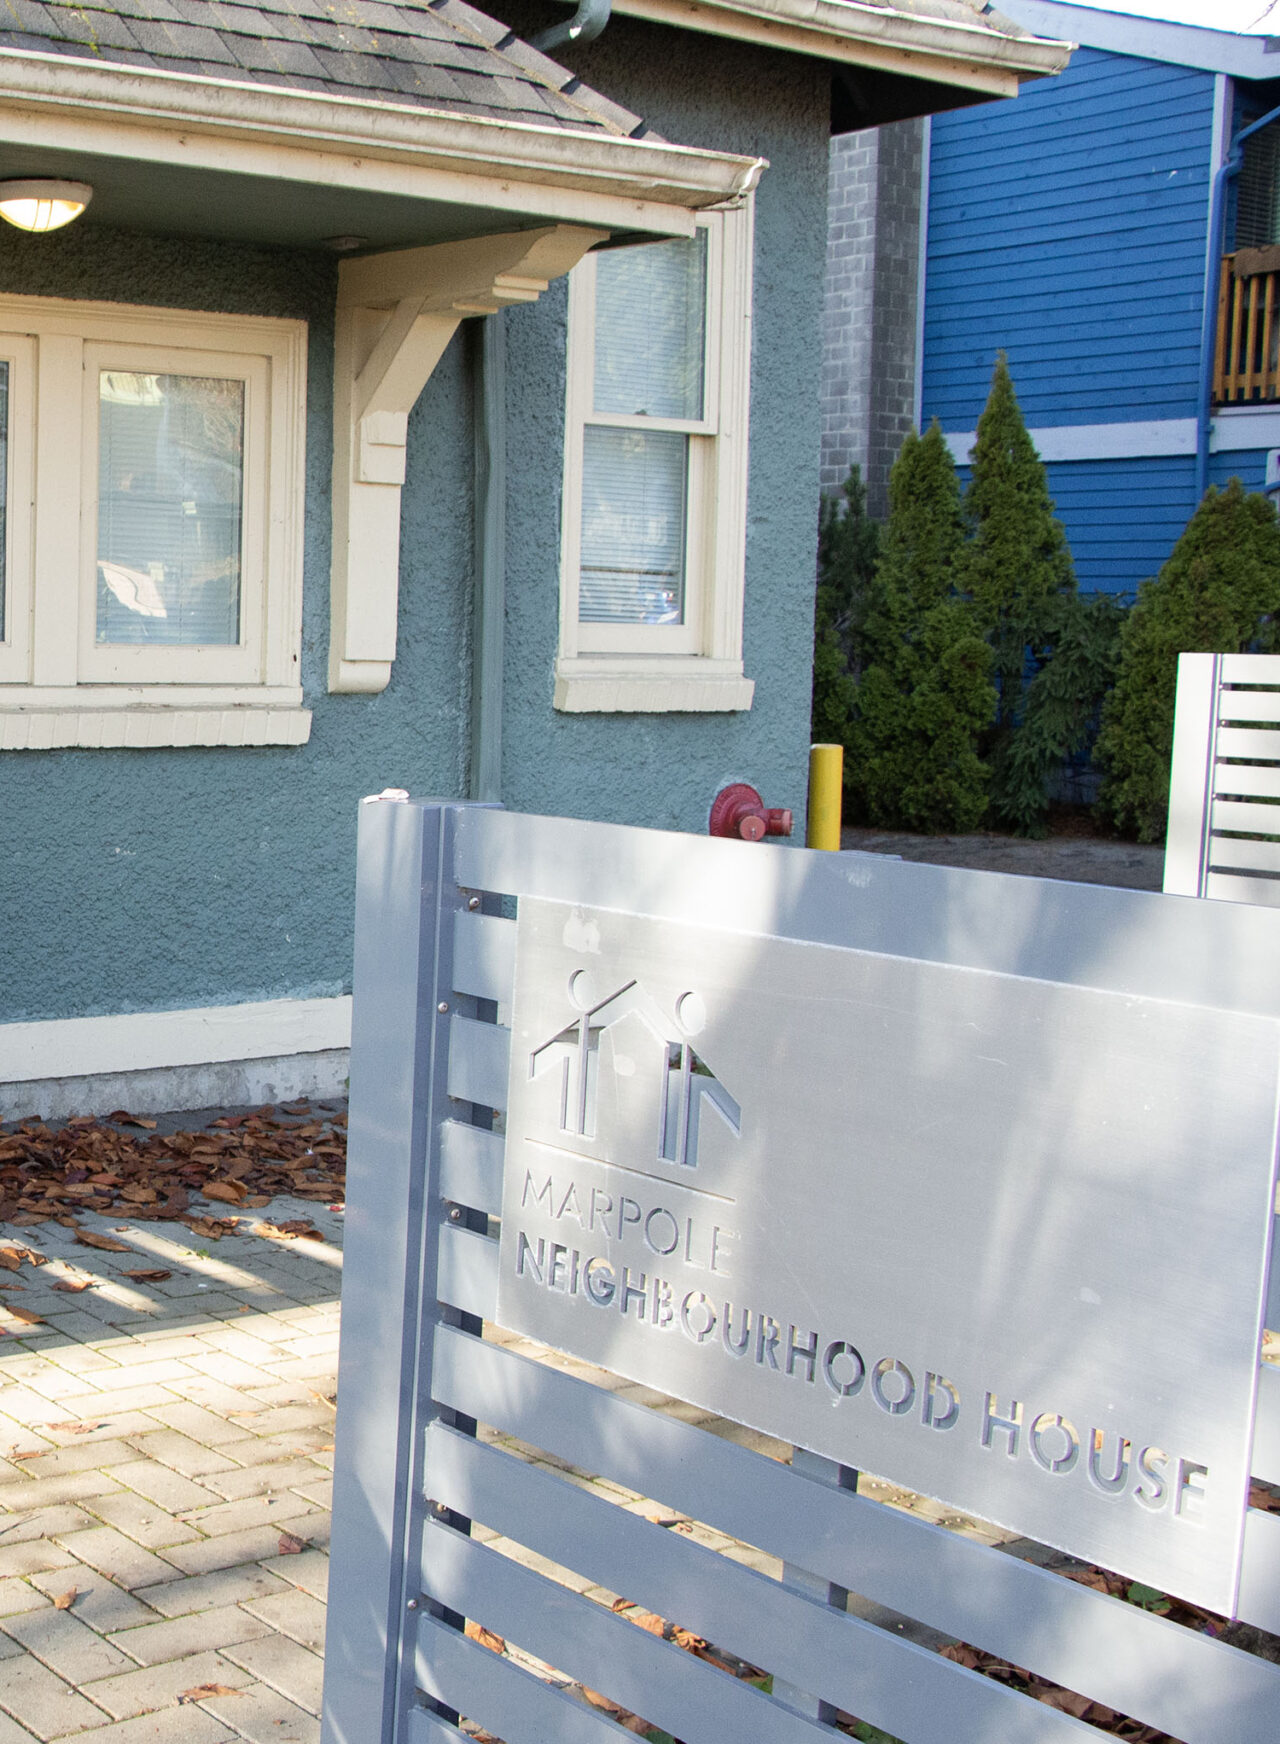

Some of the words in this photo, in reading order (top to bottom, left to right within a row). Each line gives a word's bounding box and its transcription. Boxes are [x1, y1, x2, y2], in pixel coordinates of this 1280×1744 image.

[521, 1168, 739, 1277] MARPOLE
[517, 1231, 960, 1430] NEIGHBOURHOOD
[982, 1391, 1208, 1525] HOUSE
